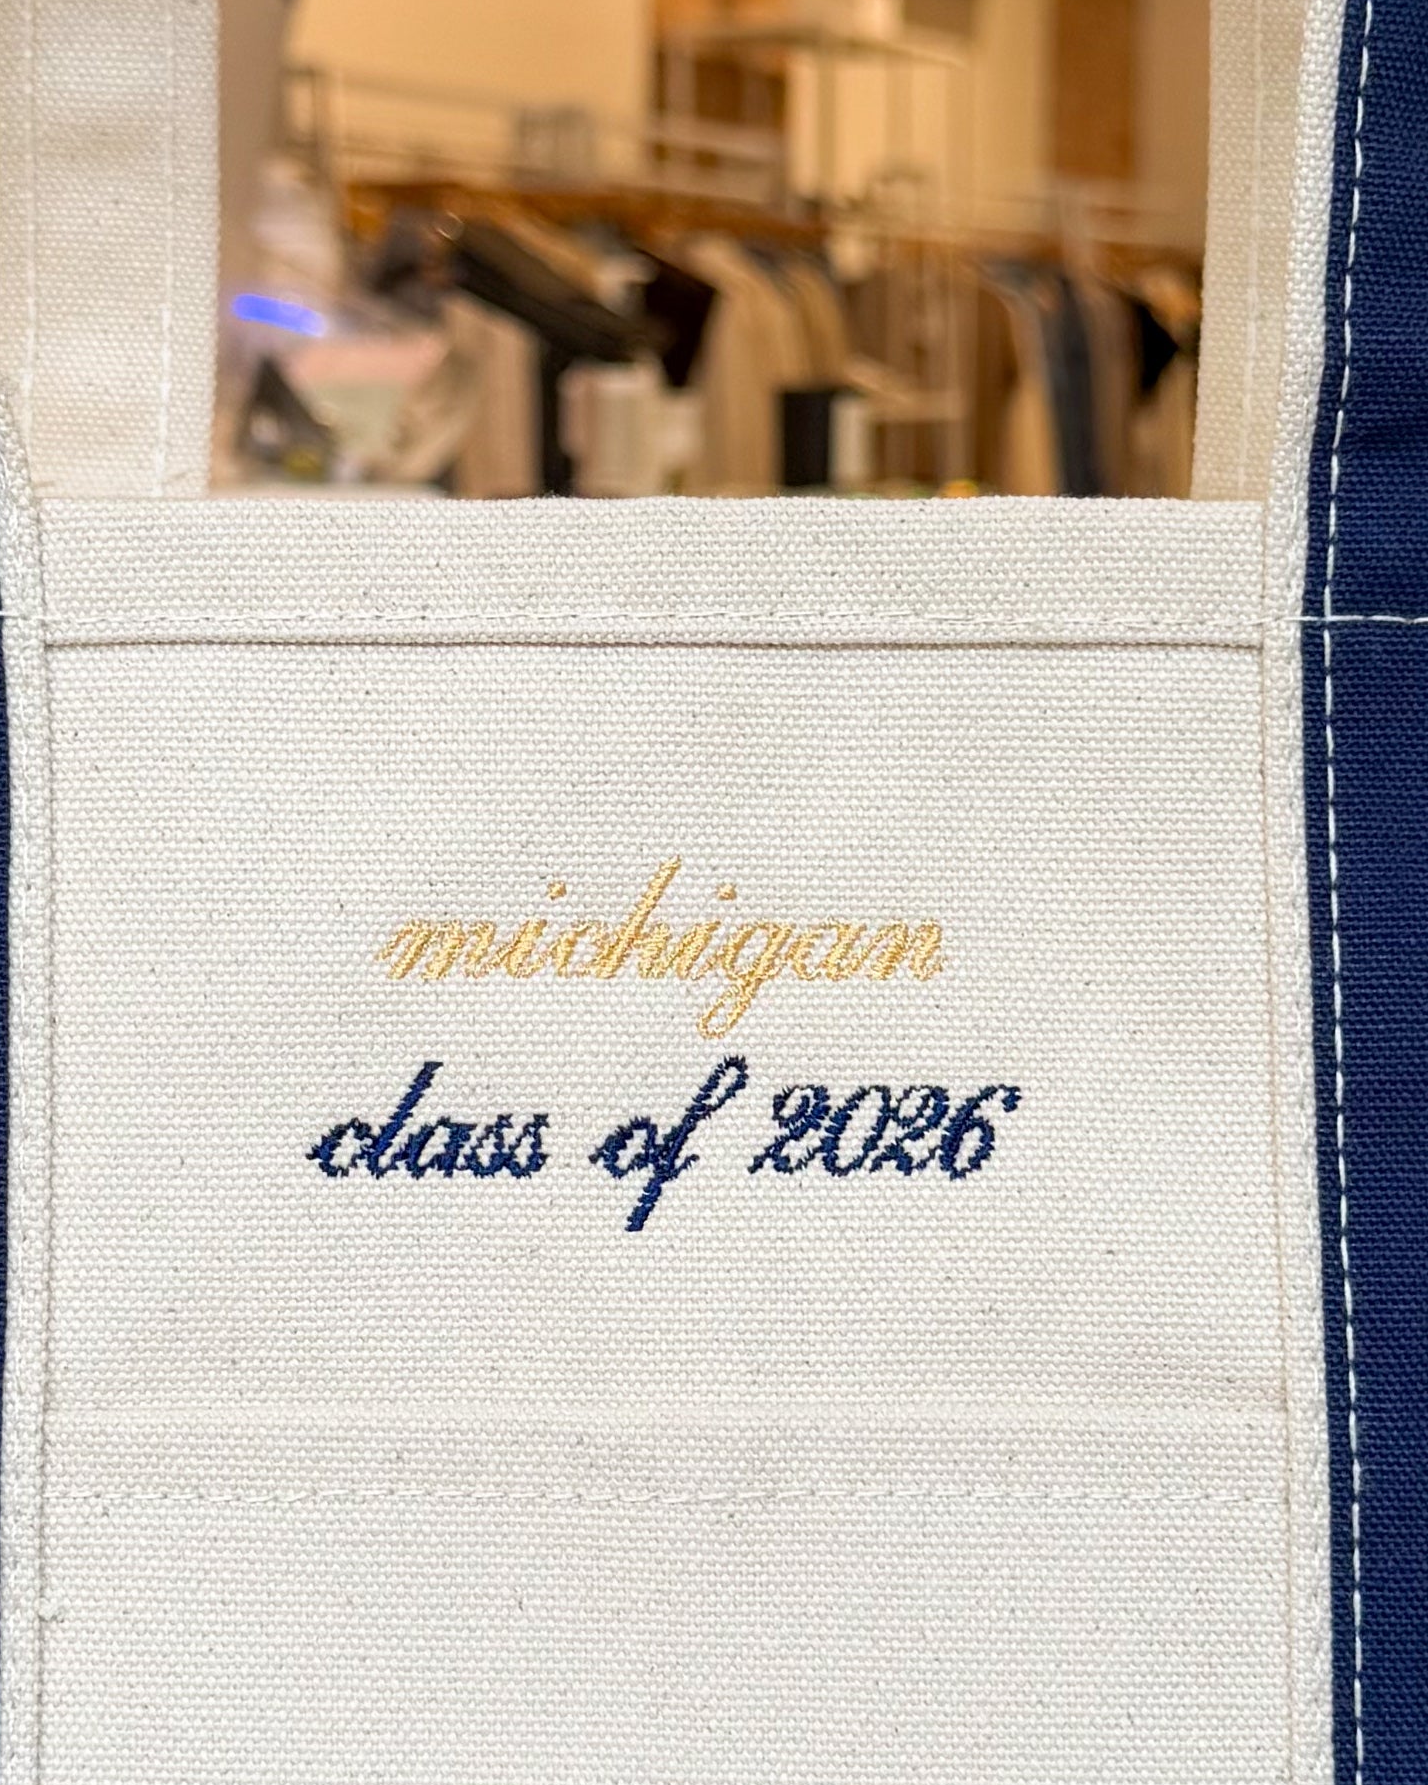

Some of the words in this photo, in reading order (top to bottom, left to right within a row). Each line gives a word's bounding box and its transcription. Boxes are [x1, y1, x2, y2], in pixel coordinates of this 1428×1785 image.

[376, 855, 946, 1039] michigan
[305, 1060, 551, 1180] class
[589, 1054, 749, 1233] of
[749, 1083, 1023, 1182] 2026
